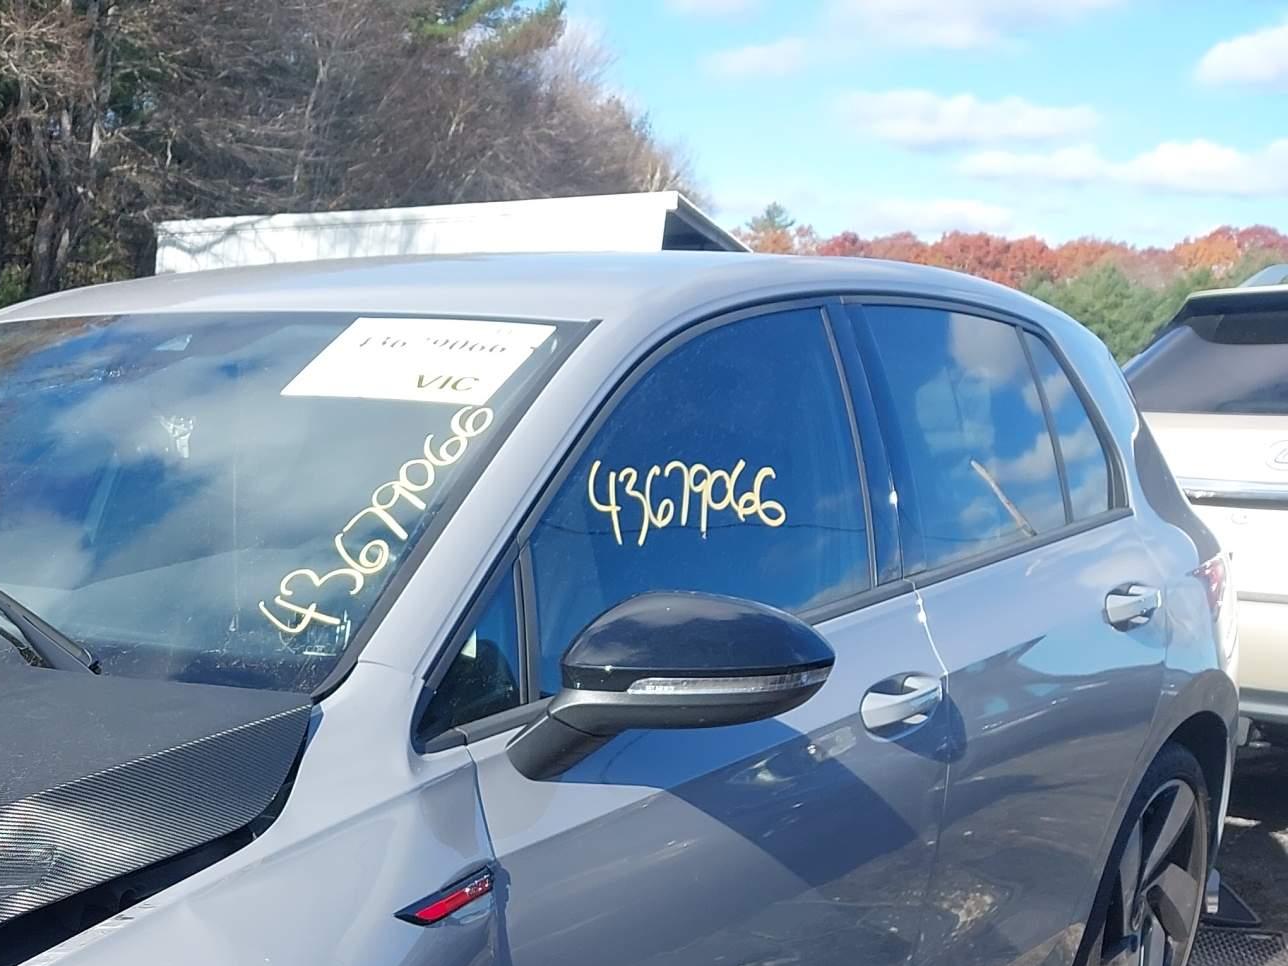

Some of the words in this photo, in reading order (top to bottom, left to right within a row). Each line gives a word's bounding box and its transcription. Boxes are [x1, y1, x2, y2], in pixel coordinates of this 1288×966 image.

[416, 374, 480, 391] VIC
[258, 405, 495, 634] 43679066
[588, 458, 787, 547] 43679066
